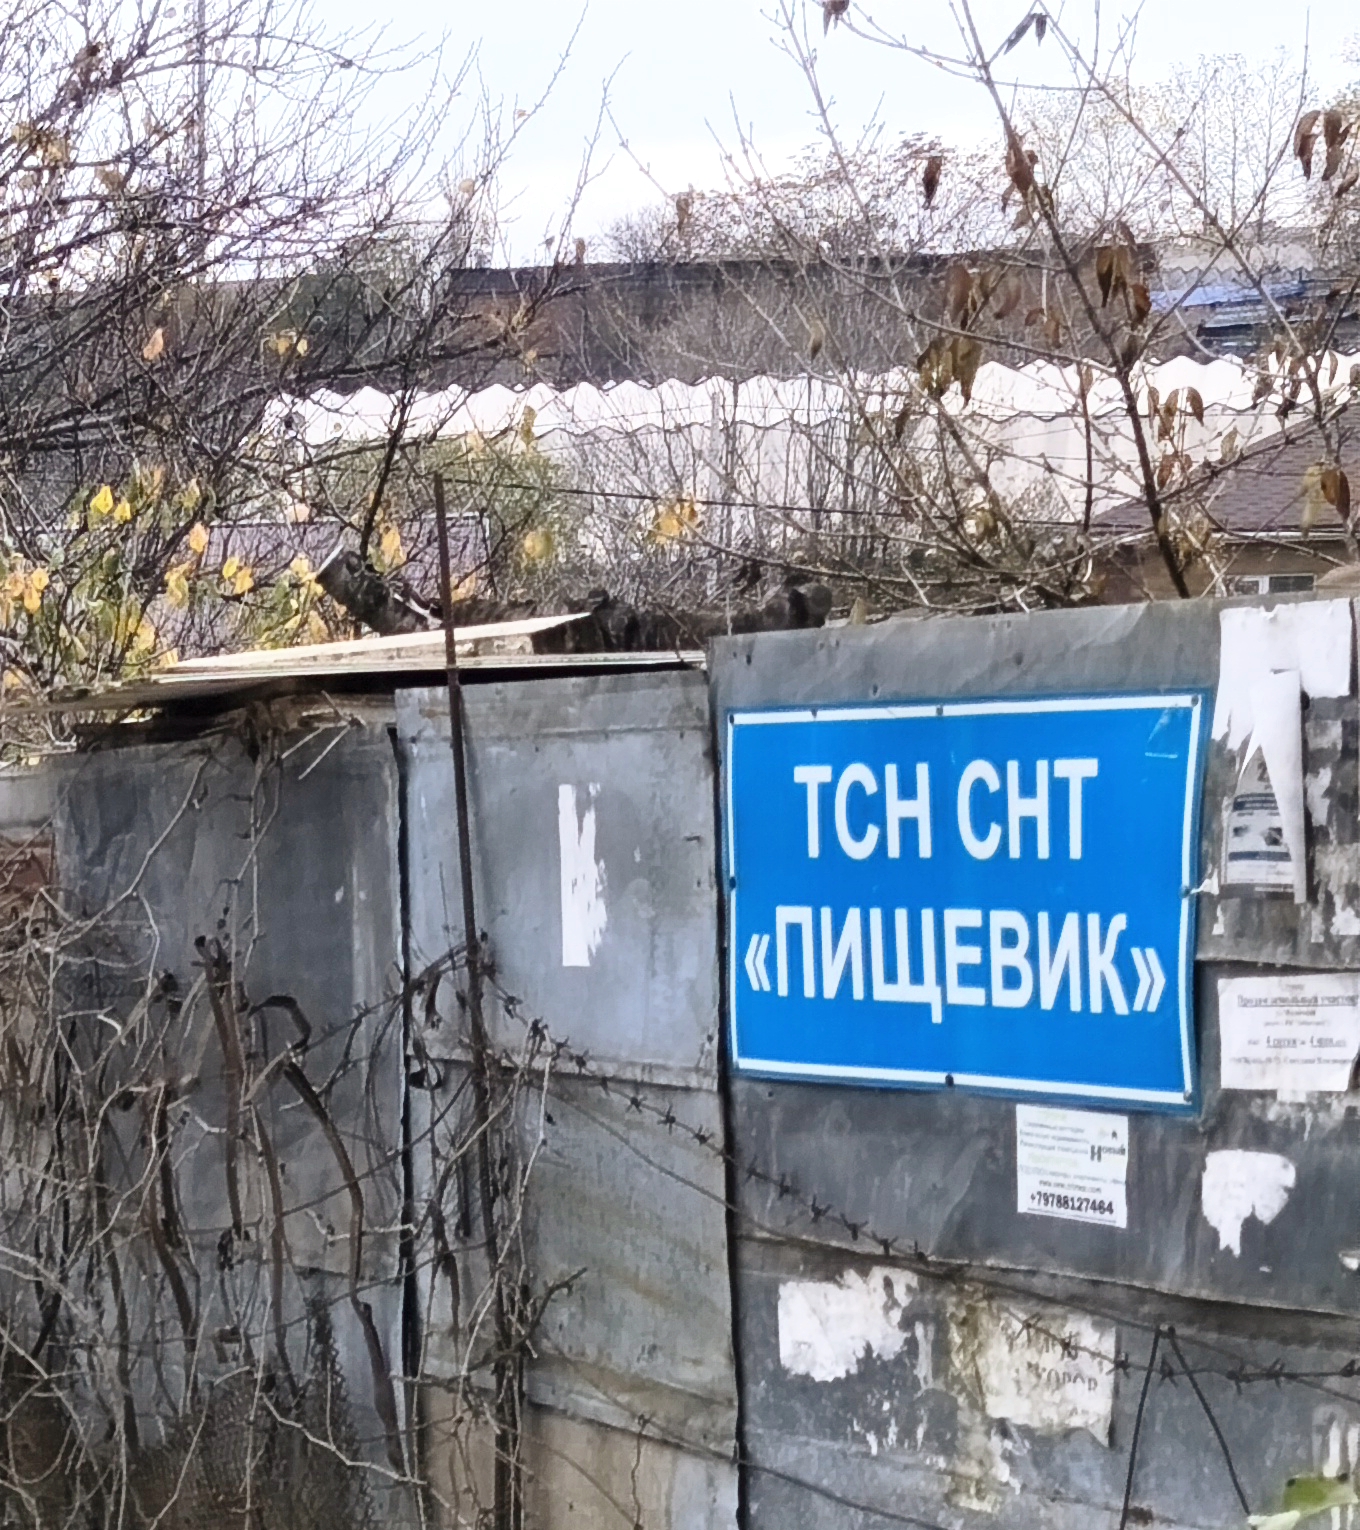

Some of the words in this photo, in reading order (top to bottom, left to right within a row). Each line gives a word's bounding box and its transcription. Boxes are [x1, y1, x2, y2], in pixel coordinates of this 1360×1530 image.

[793, 762, 932, 860] ТСН
[956, 758, 1099, 860] СНТ
[744, 905, 1167, 1024] «ПИЩЕВИК»
